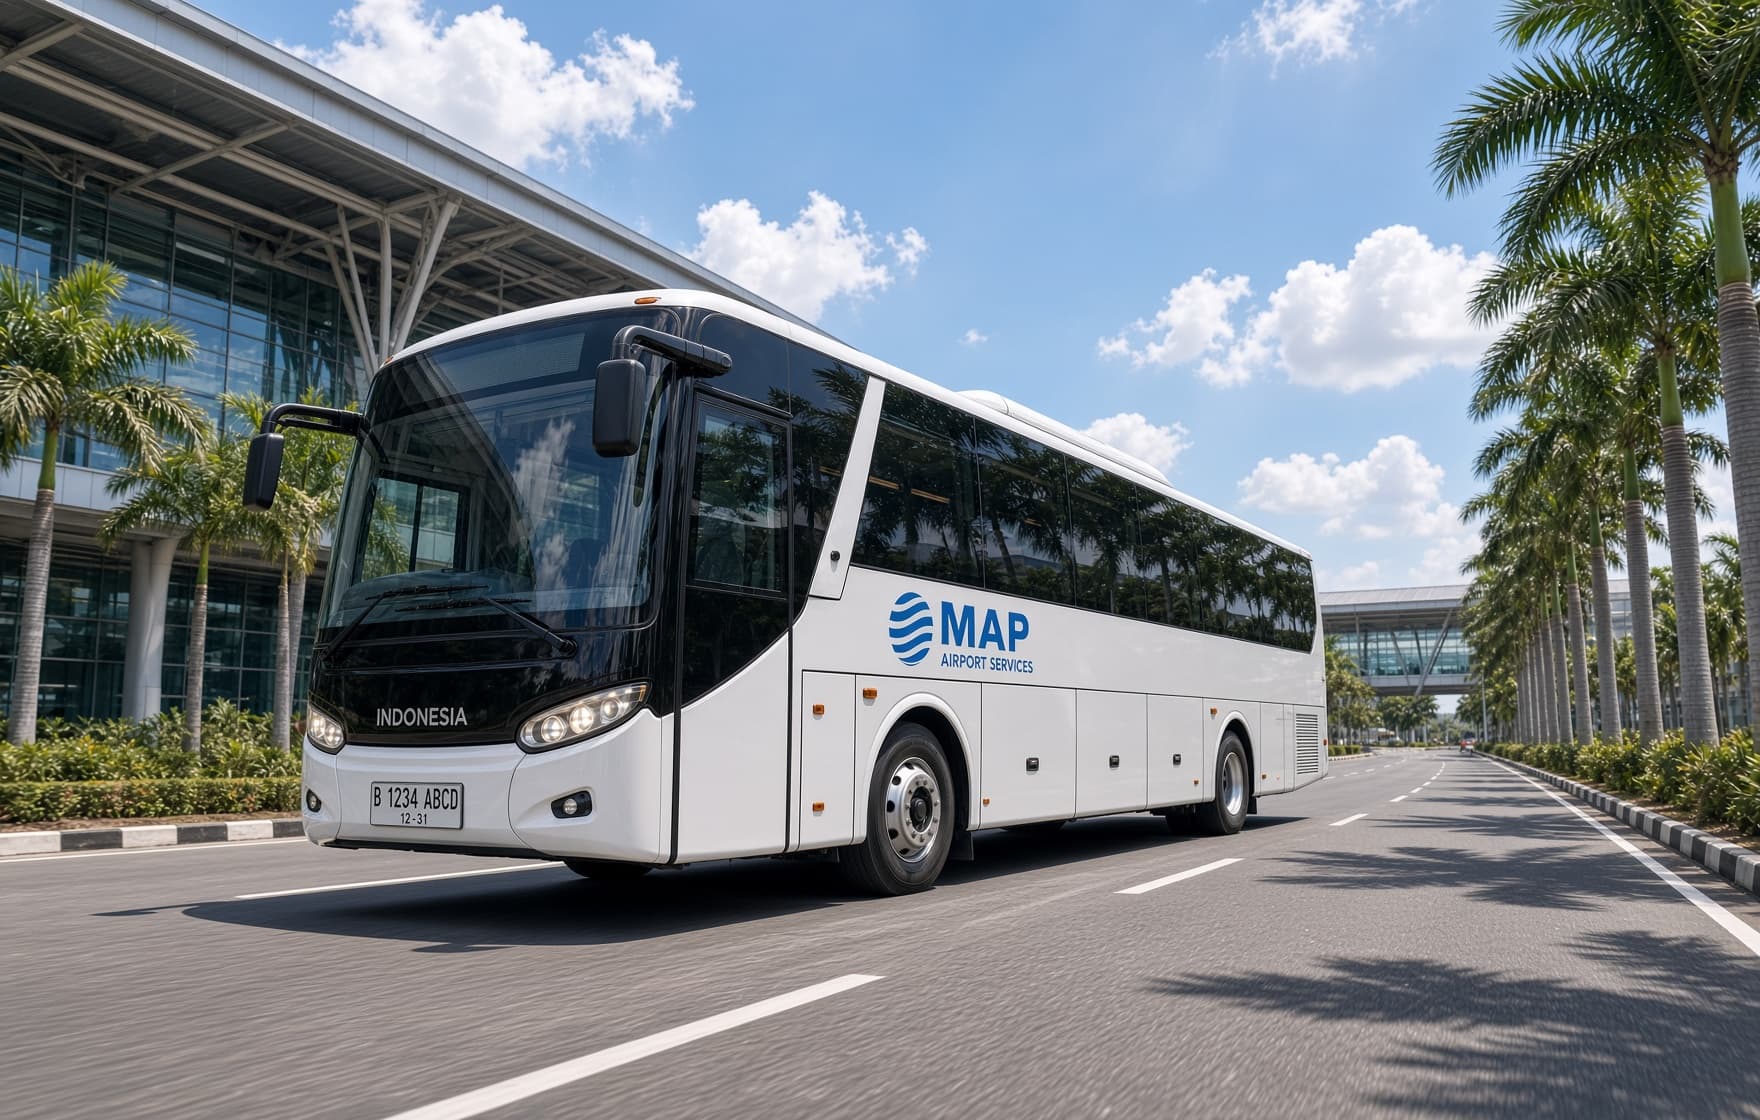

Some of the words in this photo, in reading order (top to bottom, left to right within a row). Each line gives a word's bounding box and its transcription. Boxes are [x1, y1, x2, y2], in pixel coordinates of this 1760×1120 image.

[941, 601, 1029, 652] MAP
[941, 653, 987, 669] AIRPORT
[990, 657, 1034, 673] SERVICES
[376, 707, 468, 726] INDONESIA
[374, 786, 381, 807] B
[388, 787, 418, 808] 1234
[424, 788, 458, 810] ABCD
